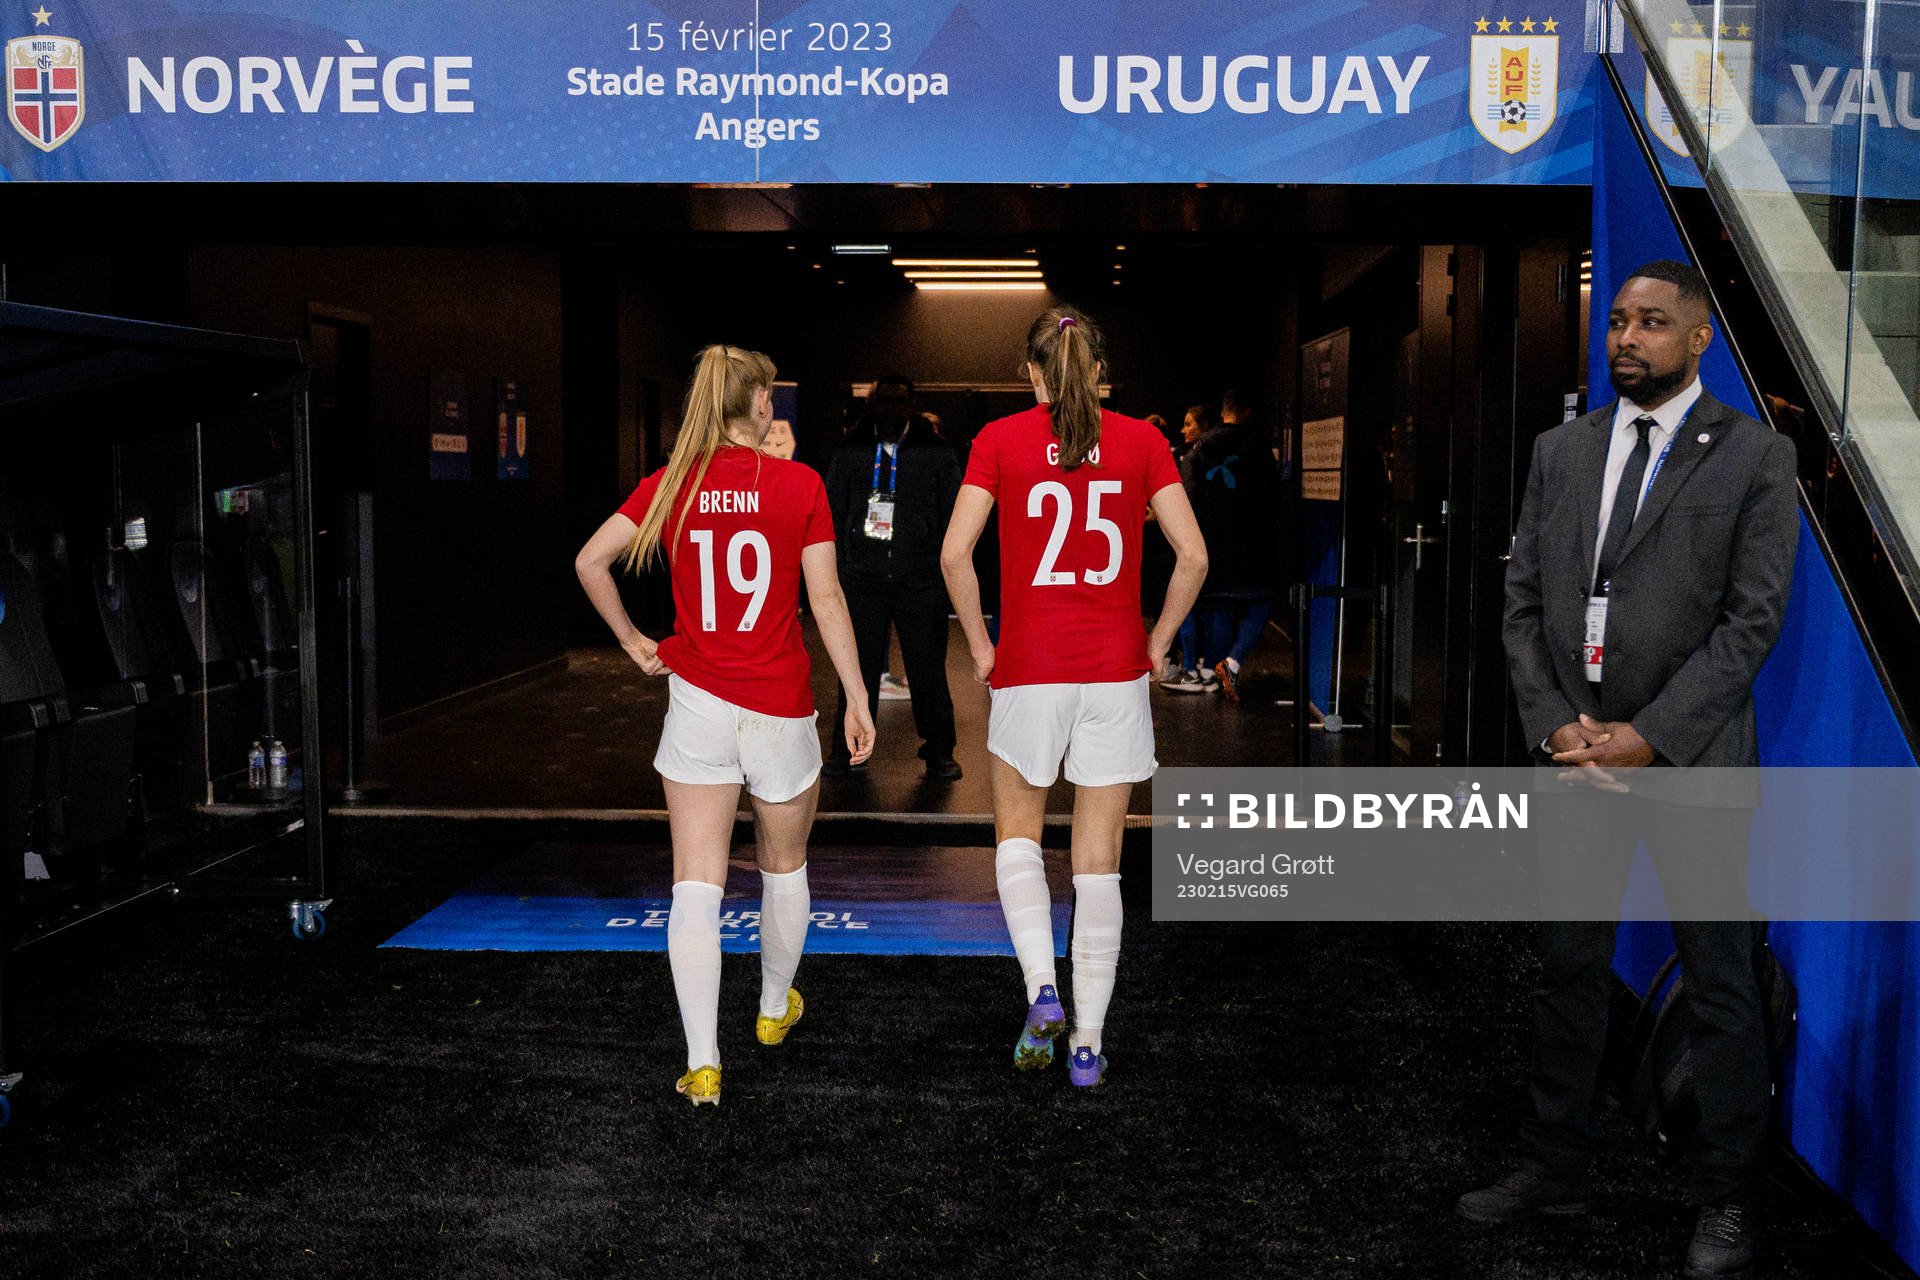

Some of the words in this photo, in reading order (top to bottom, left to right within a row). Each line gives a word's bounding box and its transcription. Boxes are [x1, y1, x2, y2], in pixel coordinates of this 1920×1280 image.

[32, 41, 56, 52] NORGE
[626, 22, 664, 51] 15
[679, 20, 792, 51] février
[808, 22, 892, 51] 2023
[127, 39, 475, 114] NORVÈGE
[567, 66, 665, 97] Stade
[676, 66, 949, 104] Raymond-Kopa
[1058, 55, 1430, 115] URUGUAY
[1505, 56, 1524, 96] AUF
[695, 112, 820, 148] Angers
[1046, 442, 1101, 466] GØ
[699, 490, 760, 514] BRENN
[1026, 480, 1123, 587] 25
[689, 529, 772, 632] 19
